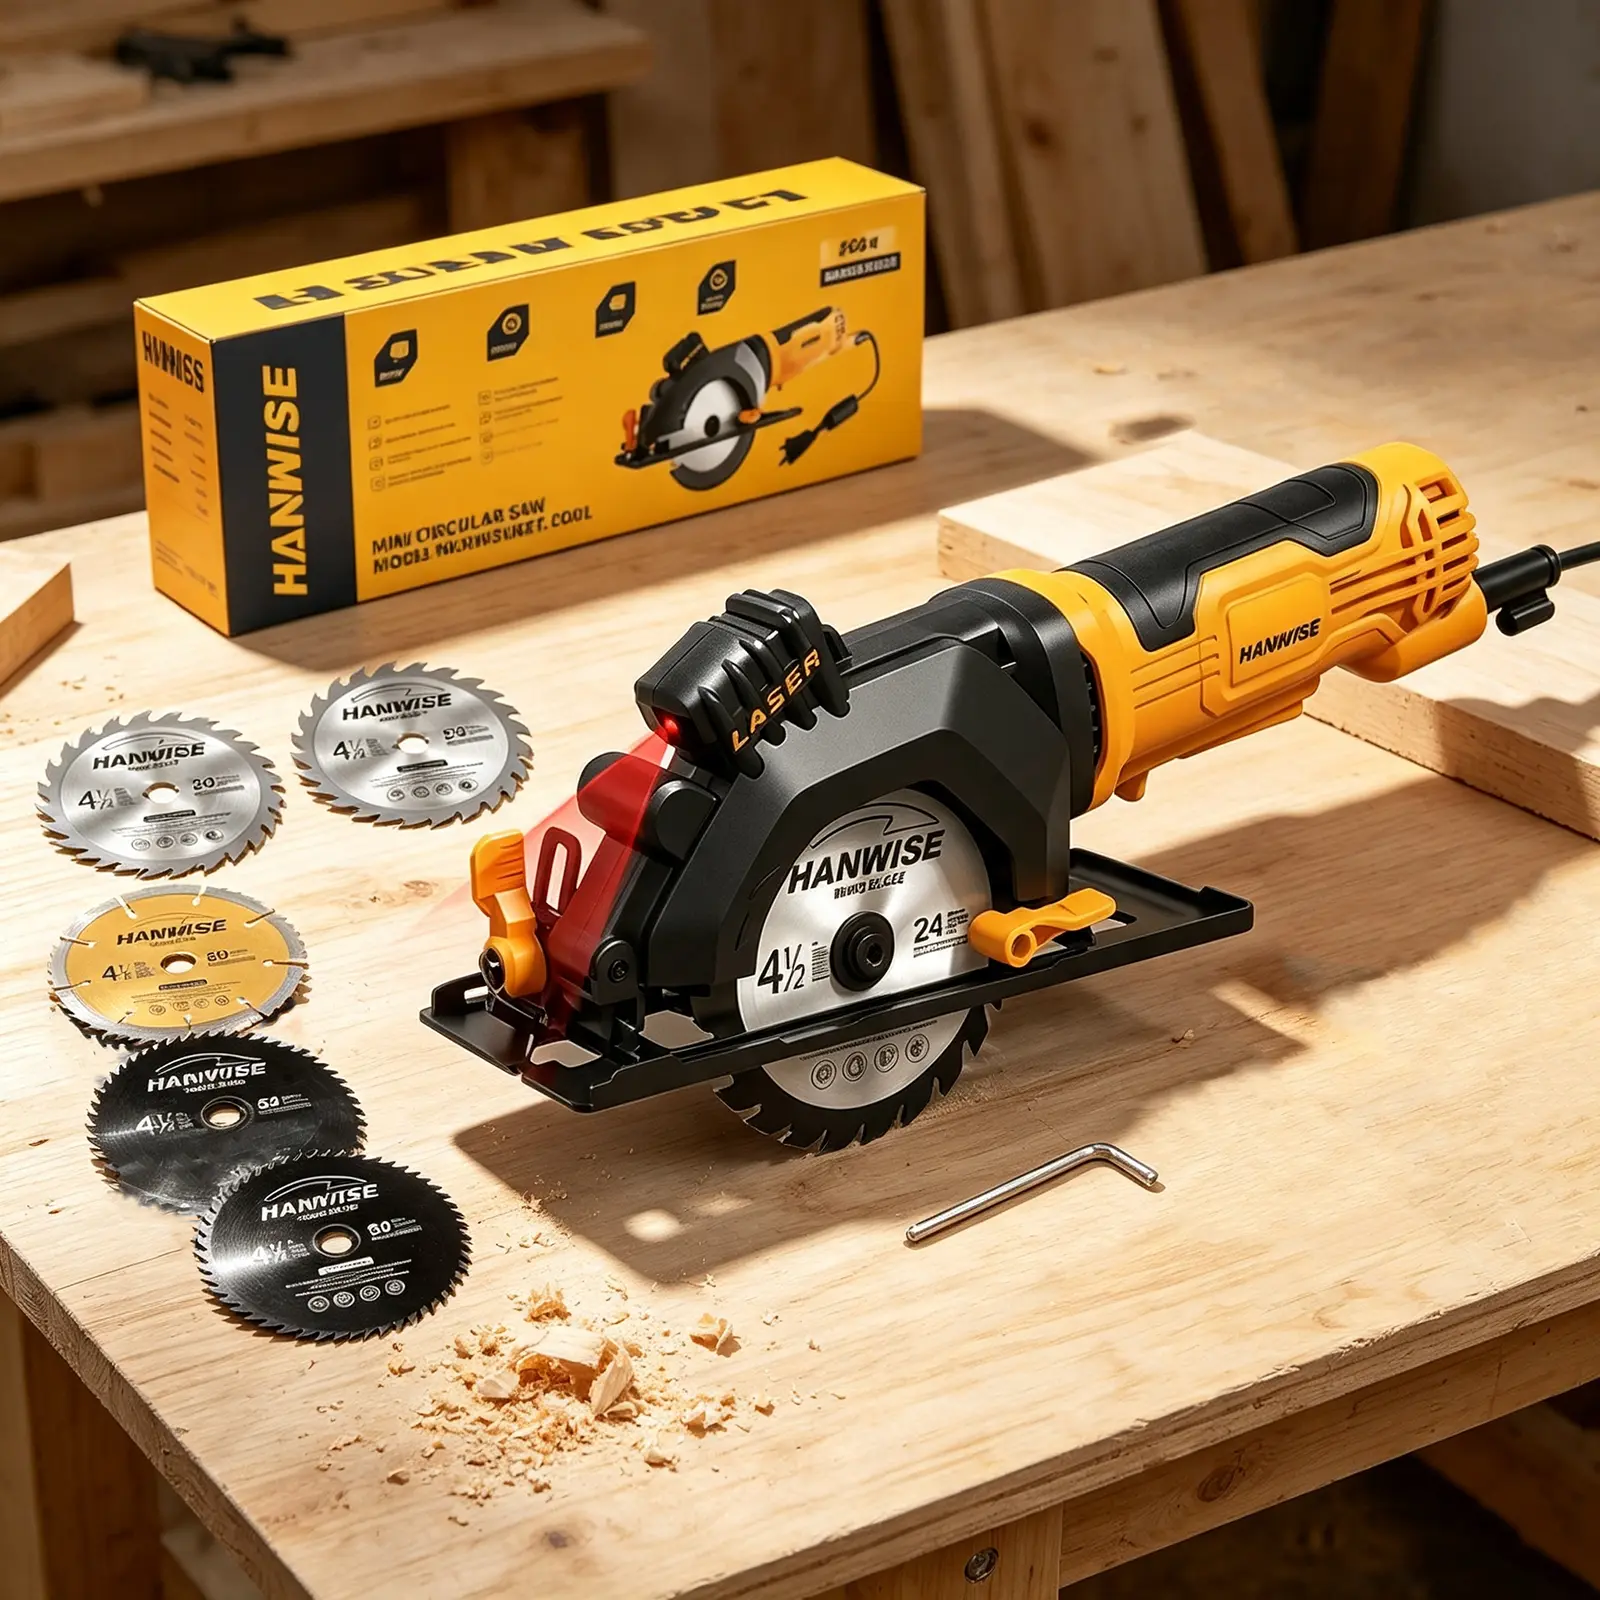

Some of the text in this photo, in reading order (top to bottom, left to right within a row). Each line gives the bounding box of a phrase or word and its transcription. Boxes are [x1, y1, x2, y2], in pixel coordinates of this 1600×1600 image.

[262, 365, 308, 596] HANWISE
[1239, 617, 1322, 665] HANWISE
[342, 692, 452, 721] HANWISE
[731, 647, 821, 753] LASER
[786, 828, 946, 895] HANWISE
[913, 912, 943, 945] 24
